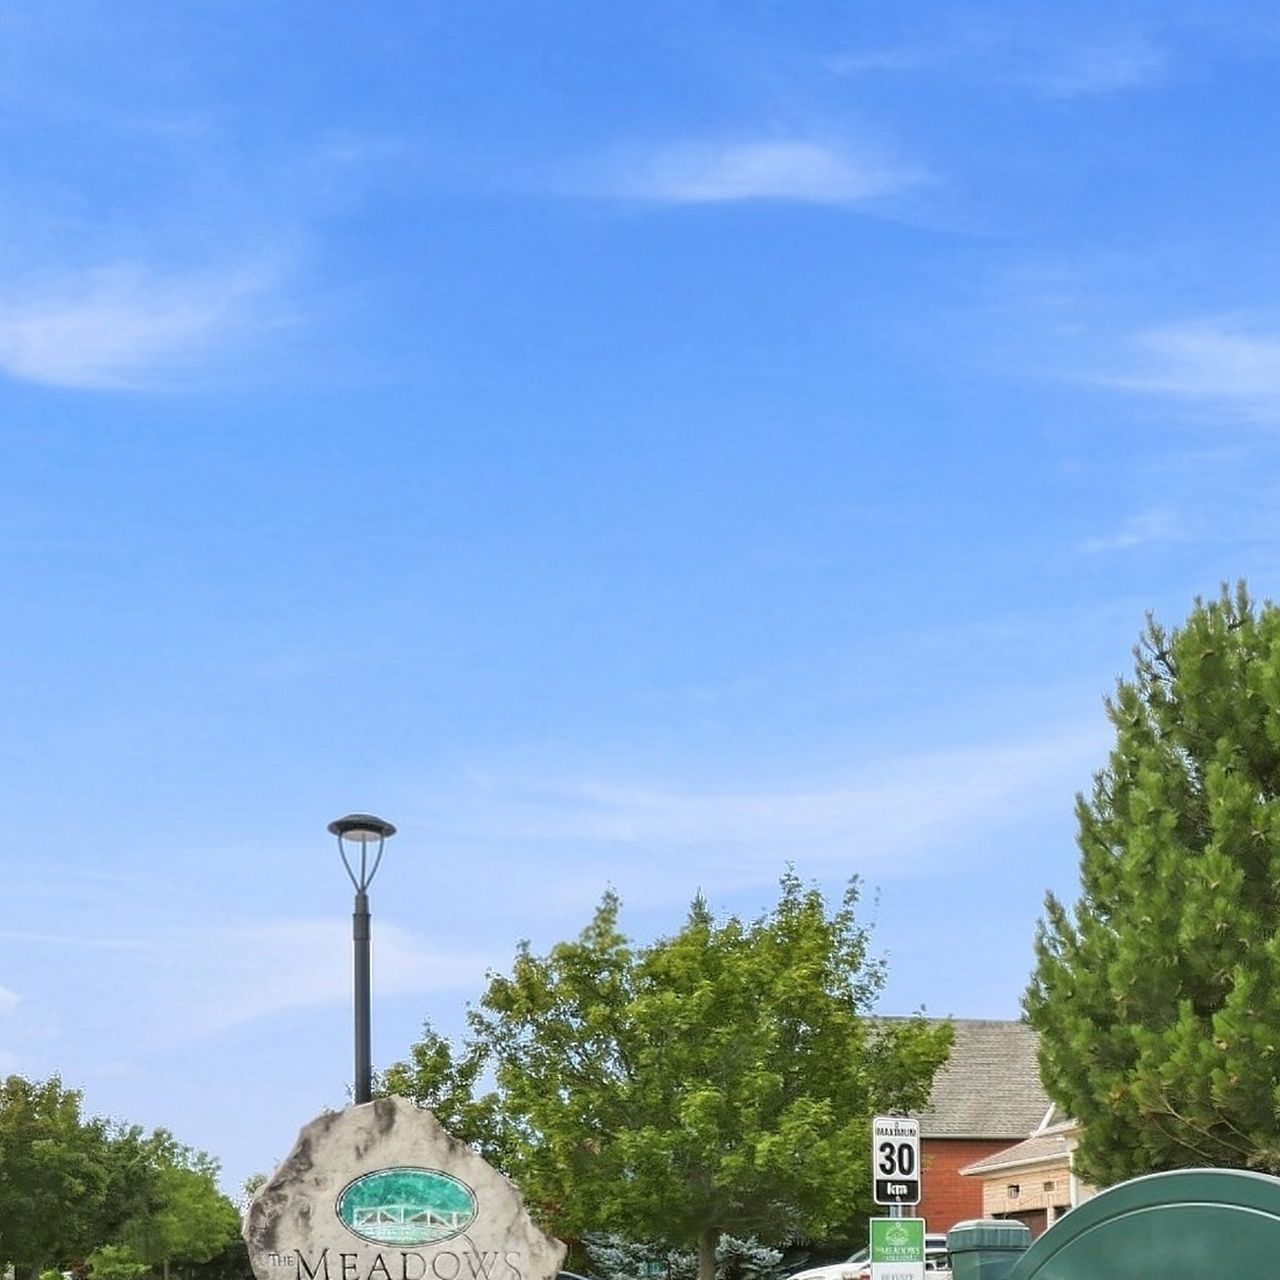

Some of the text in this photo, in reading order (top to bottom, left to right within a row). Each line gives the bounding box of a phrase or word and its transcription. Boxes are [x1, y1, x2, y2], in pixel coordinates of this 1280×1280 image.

[876, 1127, 917, 1137] MAXIMUM
[879, 1142, 915, 1175] 30
[887, 1182, 908, 1195] km
[268, 1253, 295, 1267] THE
